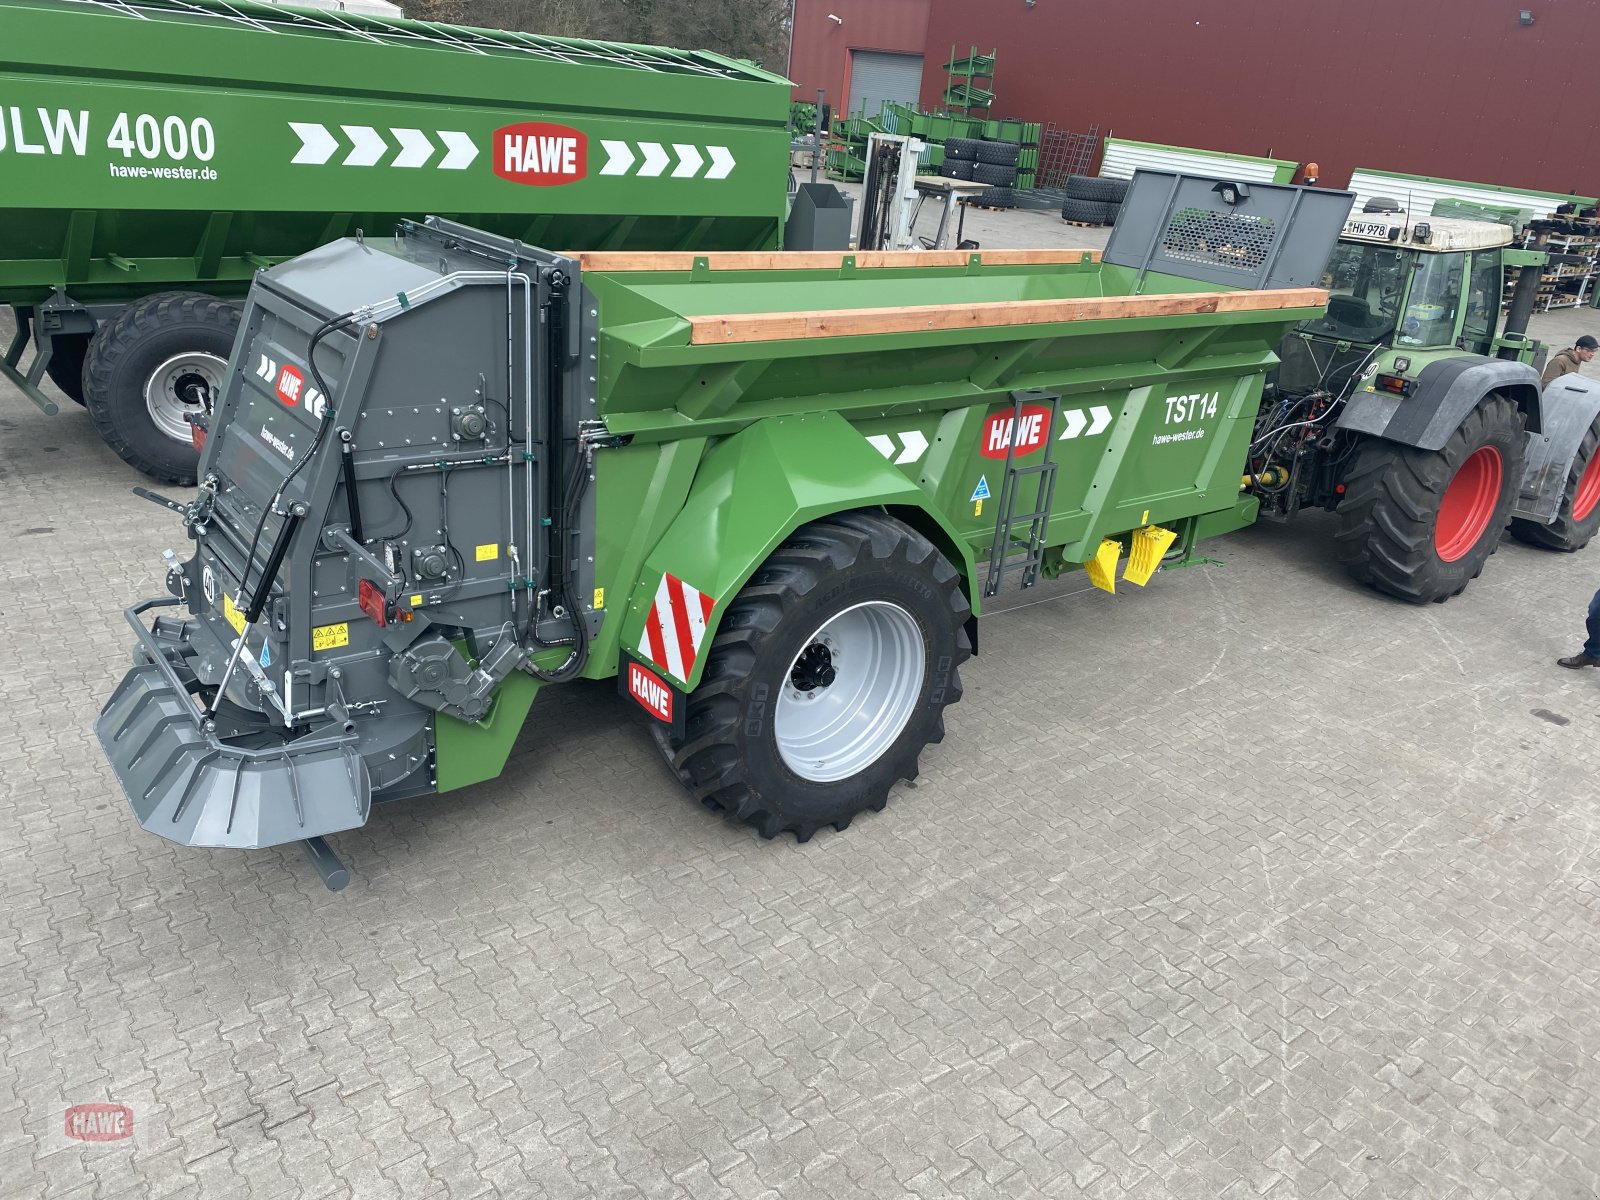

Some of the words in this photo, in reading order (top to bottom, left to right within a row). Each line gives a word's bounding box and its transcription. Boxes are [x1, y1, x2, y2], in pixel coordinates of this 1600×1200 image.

[106, 112, 215, 162] 4000
[504, 134, 577, 174] HAWE
[109, 163, 218, 180] hawe-wester.de
[279, 369, 302, 402] HAWE
[1164, 393, 1201, 425] TST
[1200, 391, 1219, 420] 14
[260, 424, 295, 461] hawe-wester.de
[988, 413, 1044, 452] HAWE
[1152, 427, 1205, 446] hawe-wester.de
[632, 667, 669, 718] HAWE
[744, 682, 769, 737] BKT
